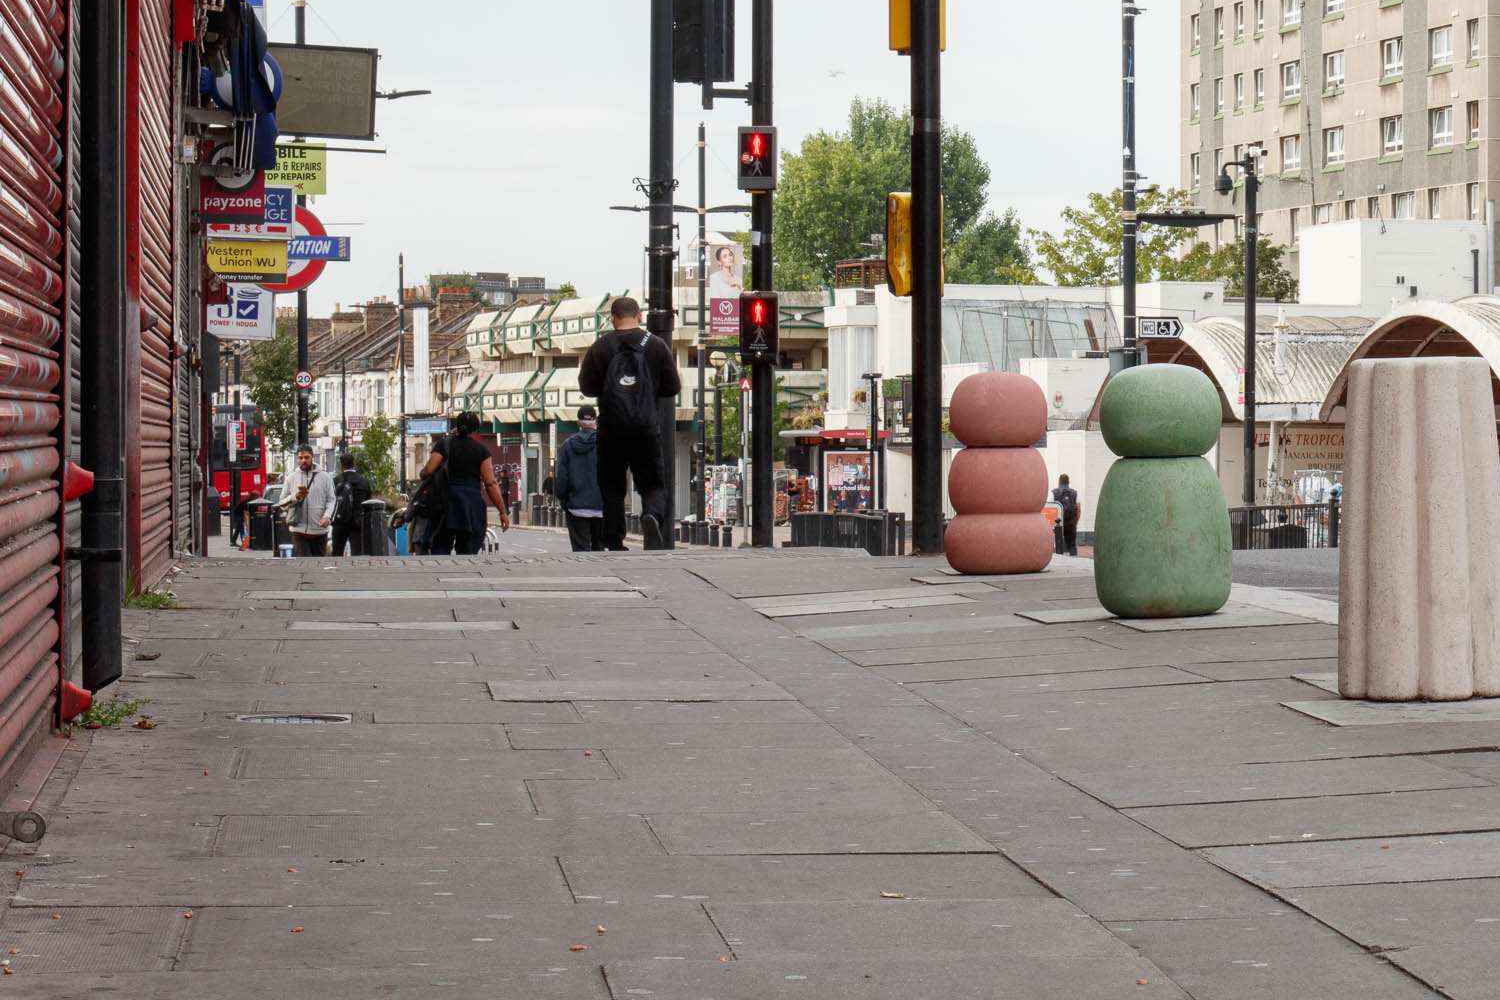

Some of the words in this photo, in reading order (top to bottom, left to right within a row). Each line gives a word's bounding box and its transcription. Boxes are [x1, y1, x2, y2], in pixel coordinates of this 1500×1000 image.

[275, 147, 307, 159] BILE
[283, 162, 289, 171] &
[281, 173, 317, 181] REPAIRS
[203, 197, 262, 211] payzone
[264, 194, 285, 206] CY
[264, 209, 288, 221] GE
[207, 246, 252, 256] Western
[219, 257, 252, 267] Union
[257, 258, 276, 268] WU
[238, 273, 264, 281] transfer
[1143, 323, 1155, 333] WC
[298, 375, 311, 383] 20
[741, 380, 750, 389] A
[1296, 433, 1344, 447] TROPICA
[1327, 451, 1344, 461] JER
